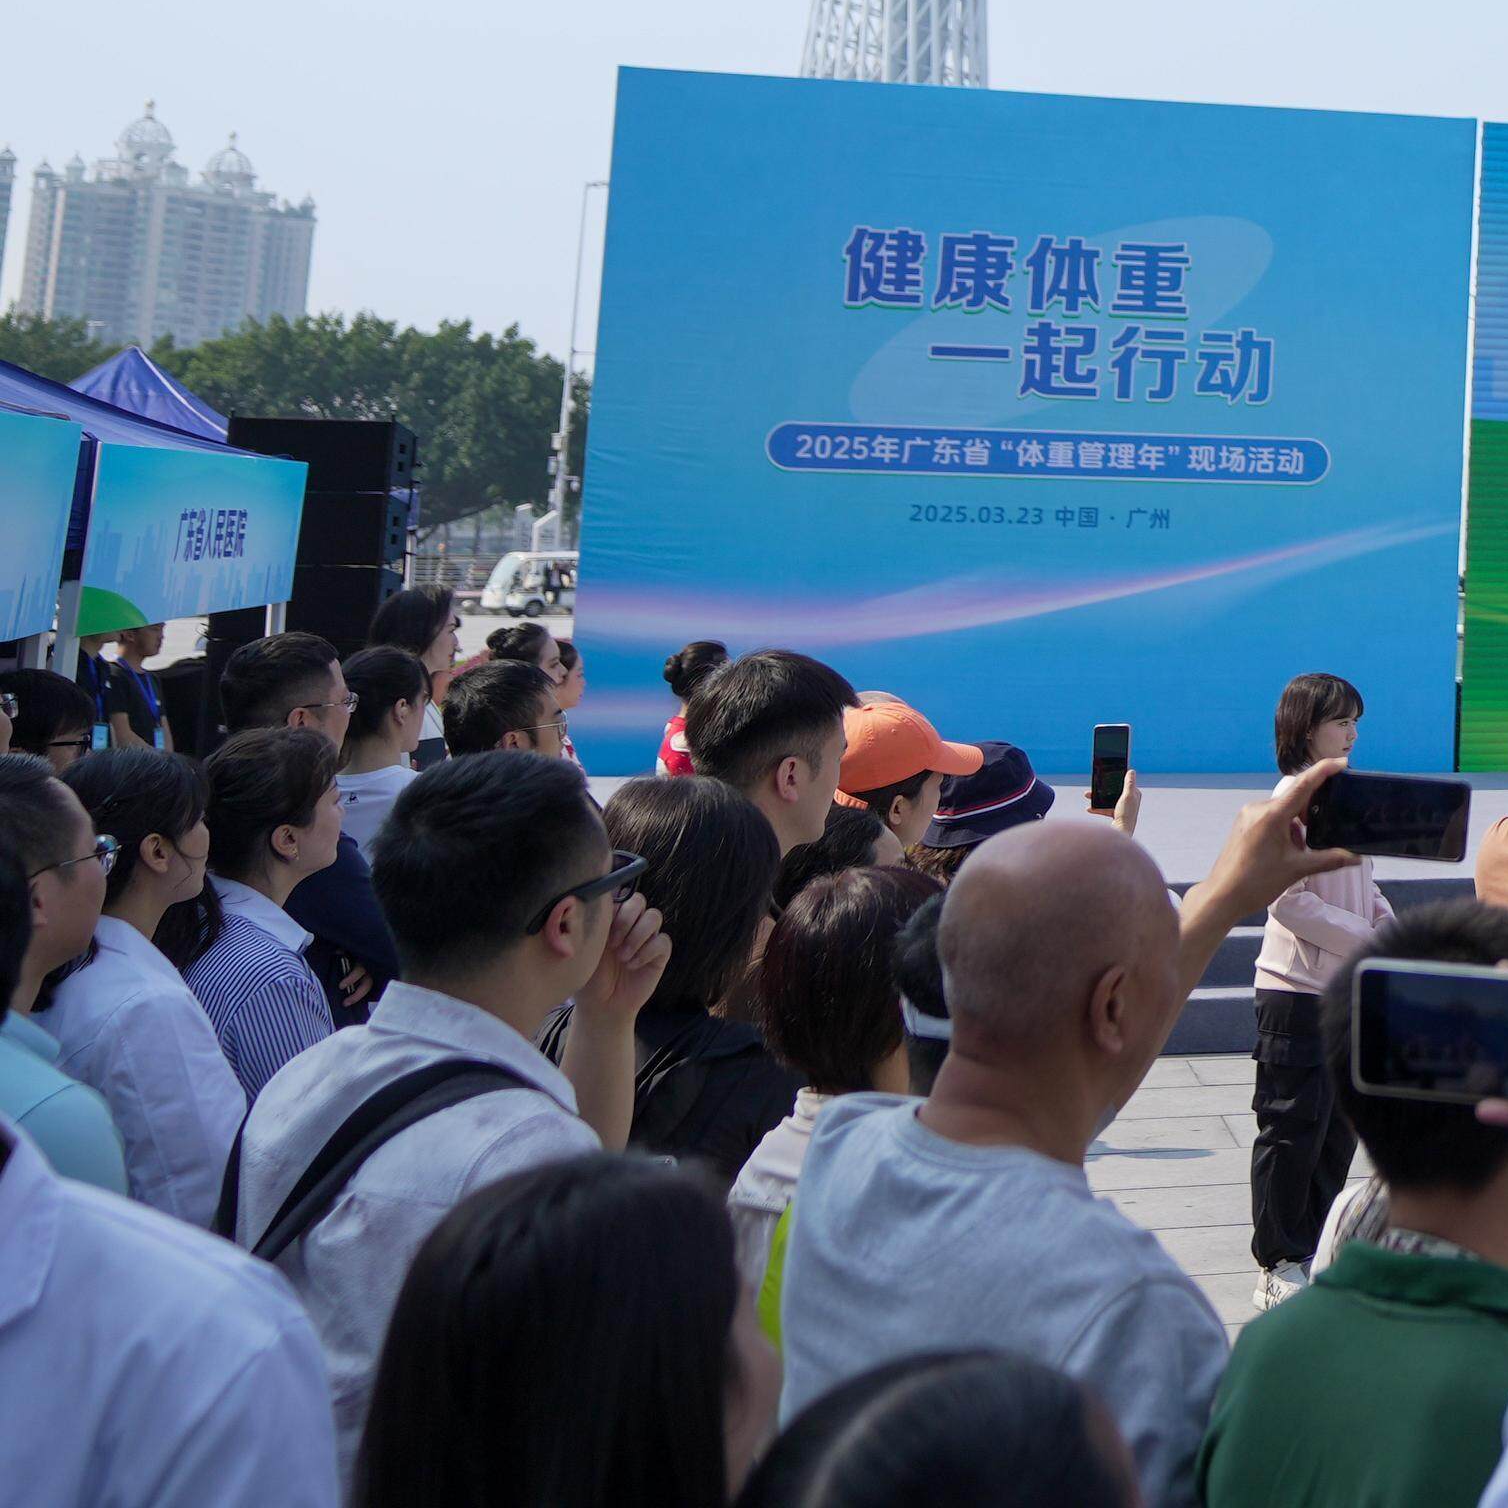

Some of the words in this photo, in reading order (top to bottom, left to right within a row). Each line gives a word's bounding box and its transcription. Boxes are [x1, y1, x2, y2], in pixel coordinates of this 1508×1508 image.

[844, 225, 1191, 318] 健康体重
[928, 322, 1274, 406] 一起行动
[173, 508, 249, 563] 广东省人民医院
[909, 503, 1046, 526] 2025.03.23
